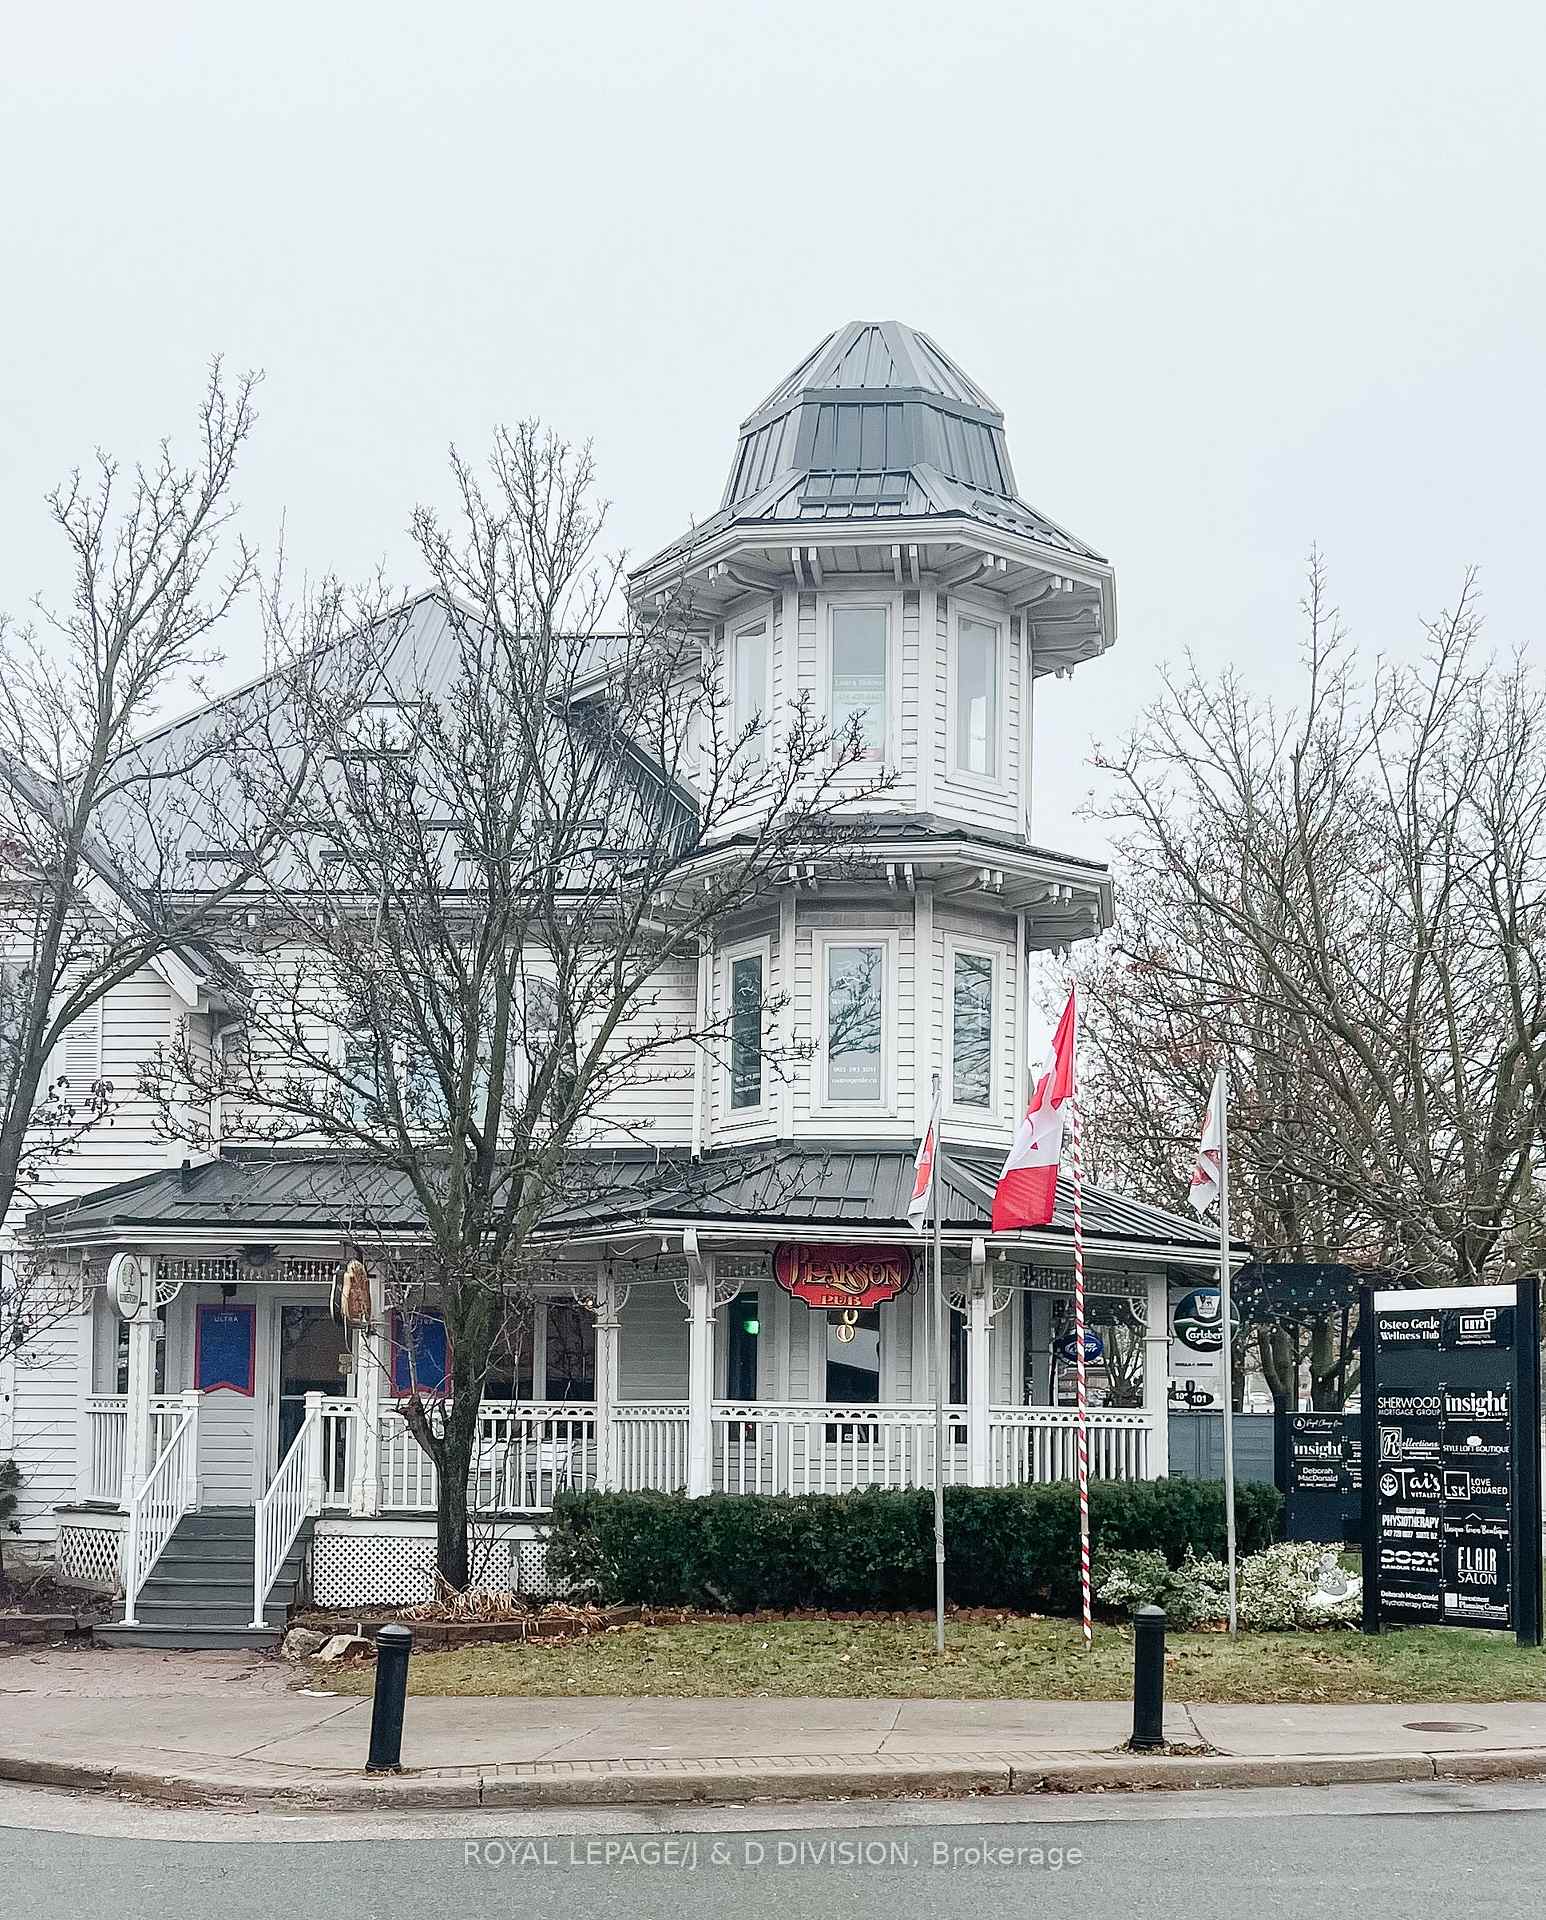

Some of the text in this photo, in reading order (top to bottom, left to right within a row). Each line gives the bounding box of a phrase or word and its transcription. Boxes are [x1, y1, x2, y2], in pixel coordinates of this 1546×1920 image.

[785, 1248, 901, 1294] PEARSON
[821, 1295, 862, 1306] PUB
[1379, 1319, 1409, 1330] Osteo
[1186, 1327, 1224, 1342] Carlsber
[1380, 1330, 1440, 1340] Wellness Hub
[1191, 1395, 1207, 1403] 101
[1377, 1396, 1441, 1409] SHERWOOD
[1445, 1391, 1508, 1417] insight
[1294, 1441, 1343, 1458] insight
[1475, 1445, 1510, 1454] BOUTIQUE
[1297, 1474, 1338, 1482] MacDonald
[1391, 1467, 1441, 1500] Tai's
[1471, 1478, 1491, 1486] LOVE
[1411, 1491, 1441, 1499] VITALITY
[1471, 1486, 1508, 1495] SQUARED
[1382, 1514, 1440, 1529] PHYSIOTHERAPY
[1458, 1547, 1497, 1571] FLAIR
[1458, 1572, 1497, 1585] SALON
[1380, 1590, 1439, 1601] Deborah MacDonald
[1381, 1599, 1439, 1610] Psychotherapy Clinic
